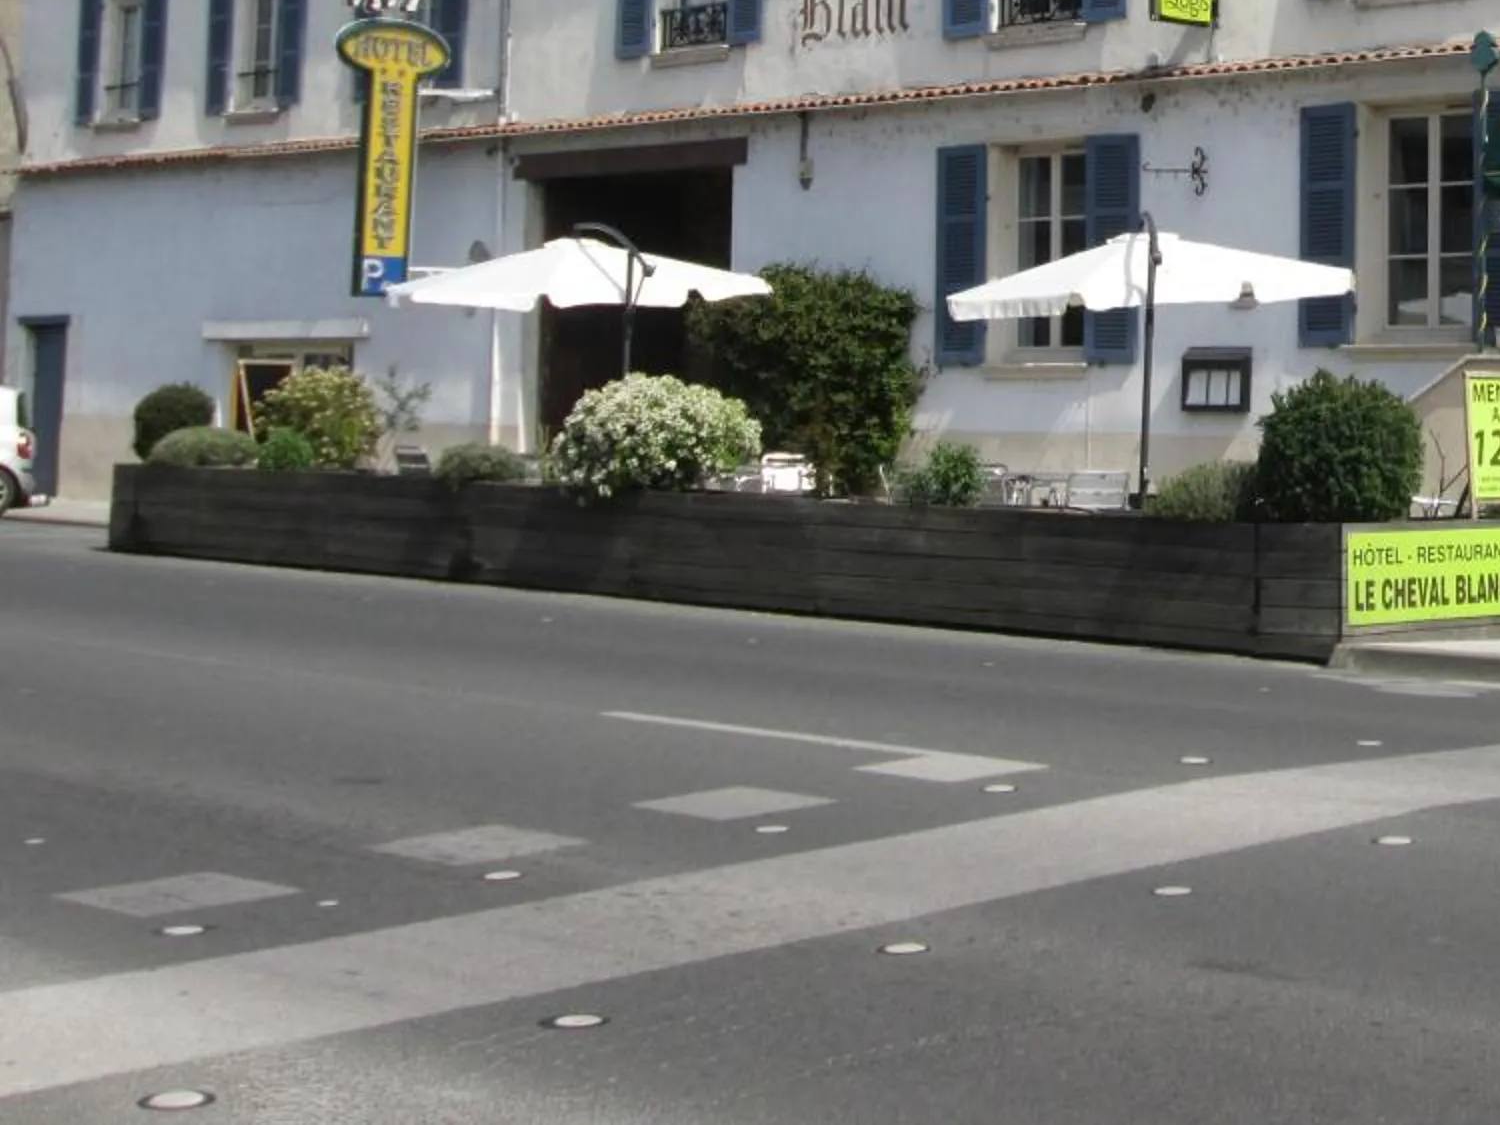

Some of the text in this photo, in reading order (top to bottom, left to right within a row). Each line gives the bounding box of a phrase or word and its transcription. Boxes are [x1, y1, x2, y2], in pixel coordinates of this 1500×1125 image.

[361, 258, 385, 292] P
[1354, 579, 1375, 613] LE
[1381, 576, 1450, 610] CHEVAL
